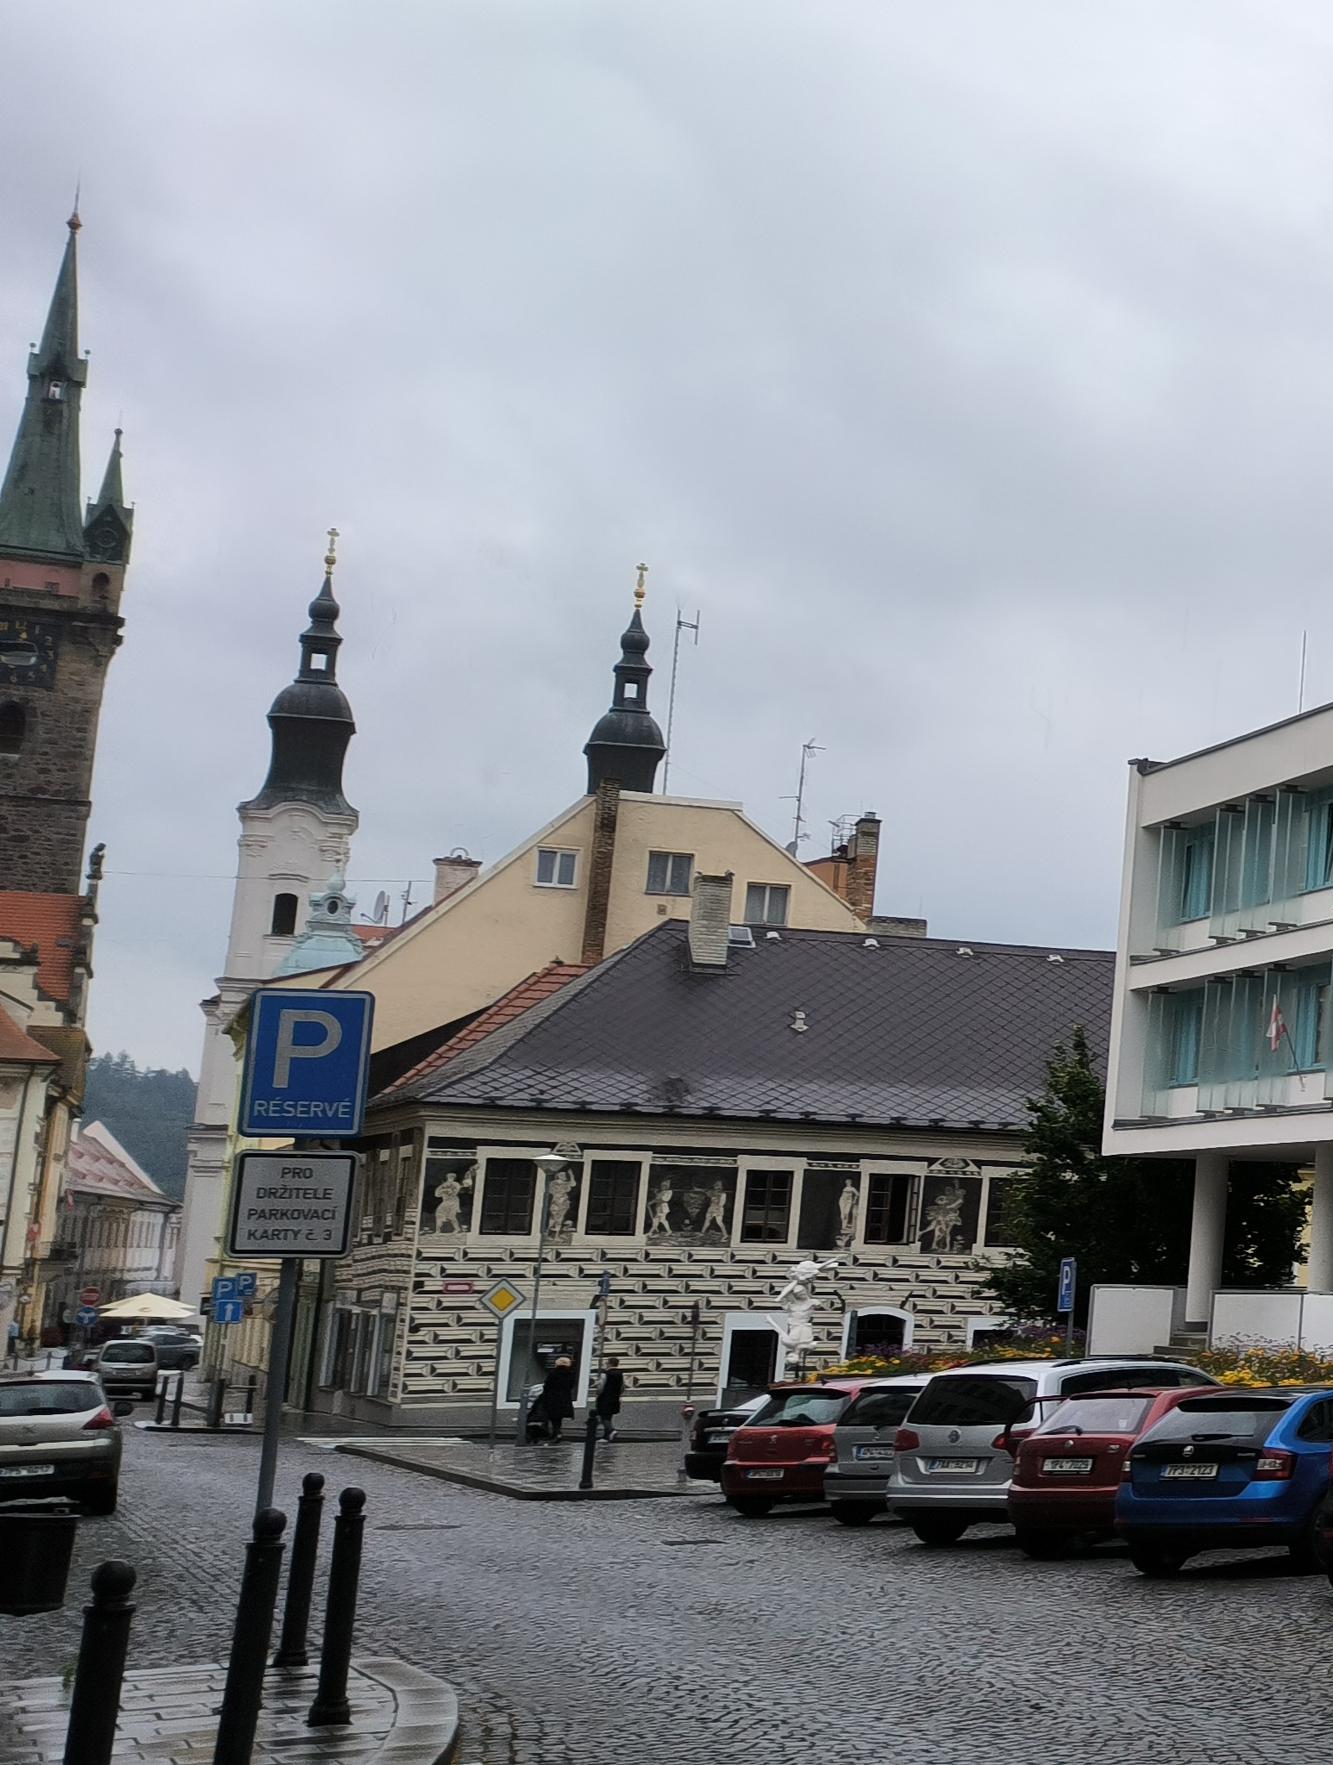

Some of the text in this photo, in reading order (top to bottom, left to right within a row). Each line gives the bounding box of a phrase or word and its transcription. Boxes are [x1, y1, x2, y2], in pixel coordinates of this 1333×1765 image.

[272, 1008, 342, 1089] P
[253, 1097, 353, 1118] RÉSERVÉ
[280, 1167, 314, 1179] PRO
[256, 1184, 334, 1200] DRŽITELE
[247, 1205, 338, 1220] PARKOVACÍ
[247, 1228, 302, 1240] KARTY
[323, 1229, 332, 1240] 3
[239, 1275, 252, 1290] P
[1062, 1265, 1071, 1295] P
[216, 1281, 233, 1298] P
